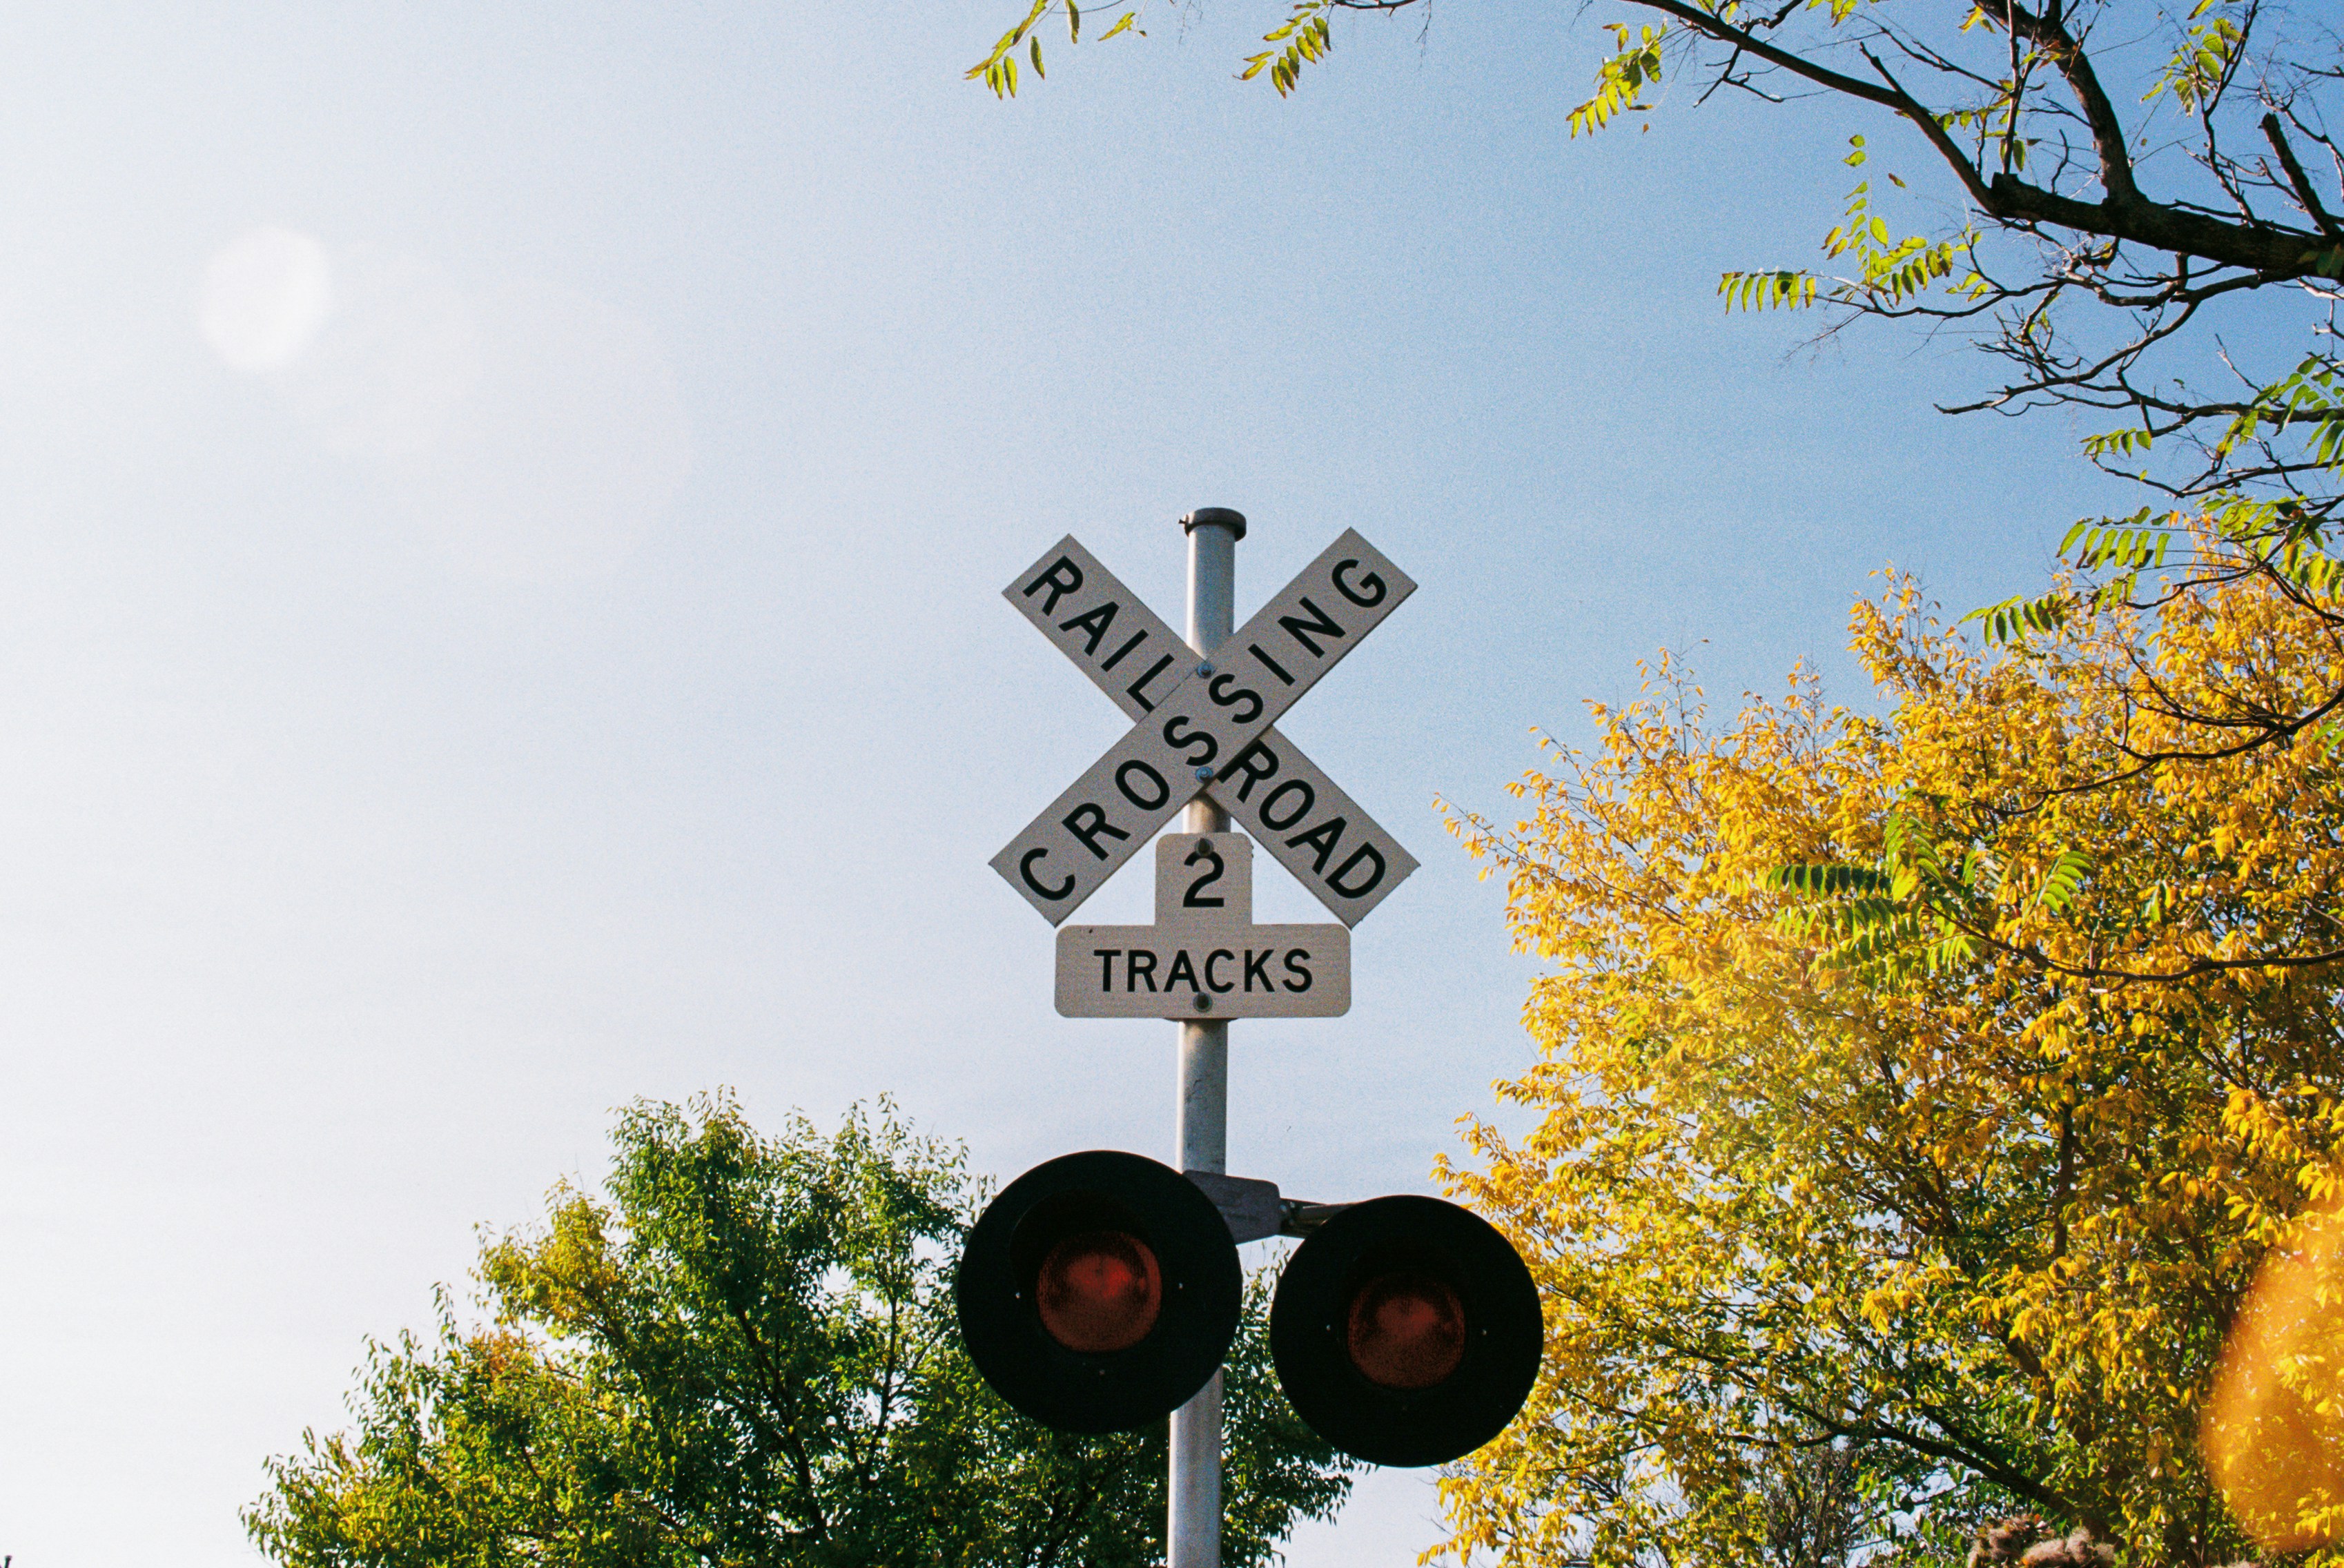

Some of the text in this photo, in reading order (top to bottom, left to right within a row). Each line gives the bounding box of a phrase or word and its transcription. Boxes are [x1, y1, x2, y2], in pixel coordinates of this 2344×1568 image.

[1019, 558, 1387, 901] CROSSING
[1022, 555, 1387, 899] RAIL ROAD
[1093, 948, 1313, 994] TRACKS
[1182, 850, 1224, 908] 2
